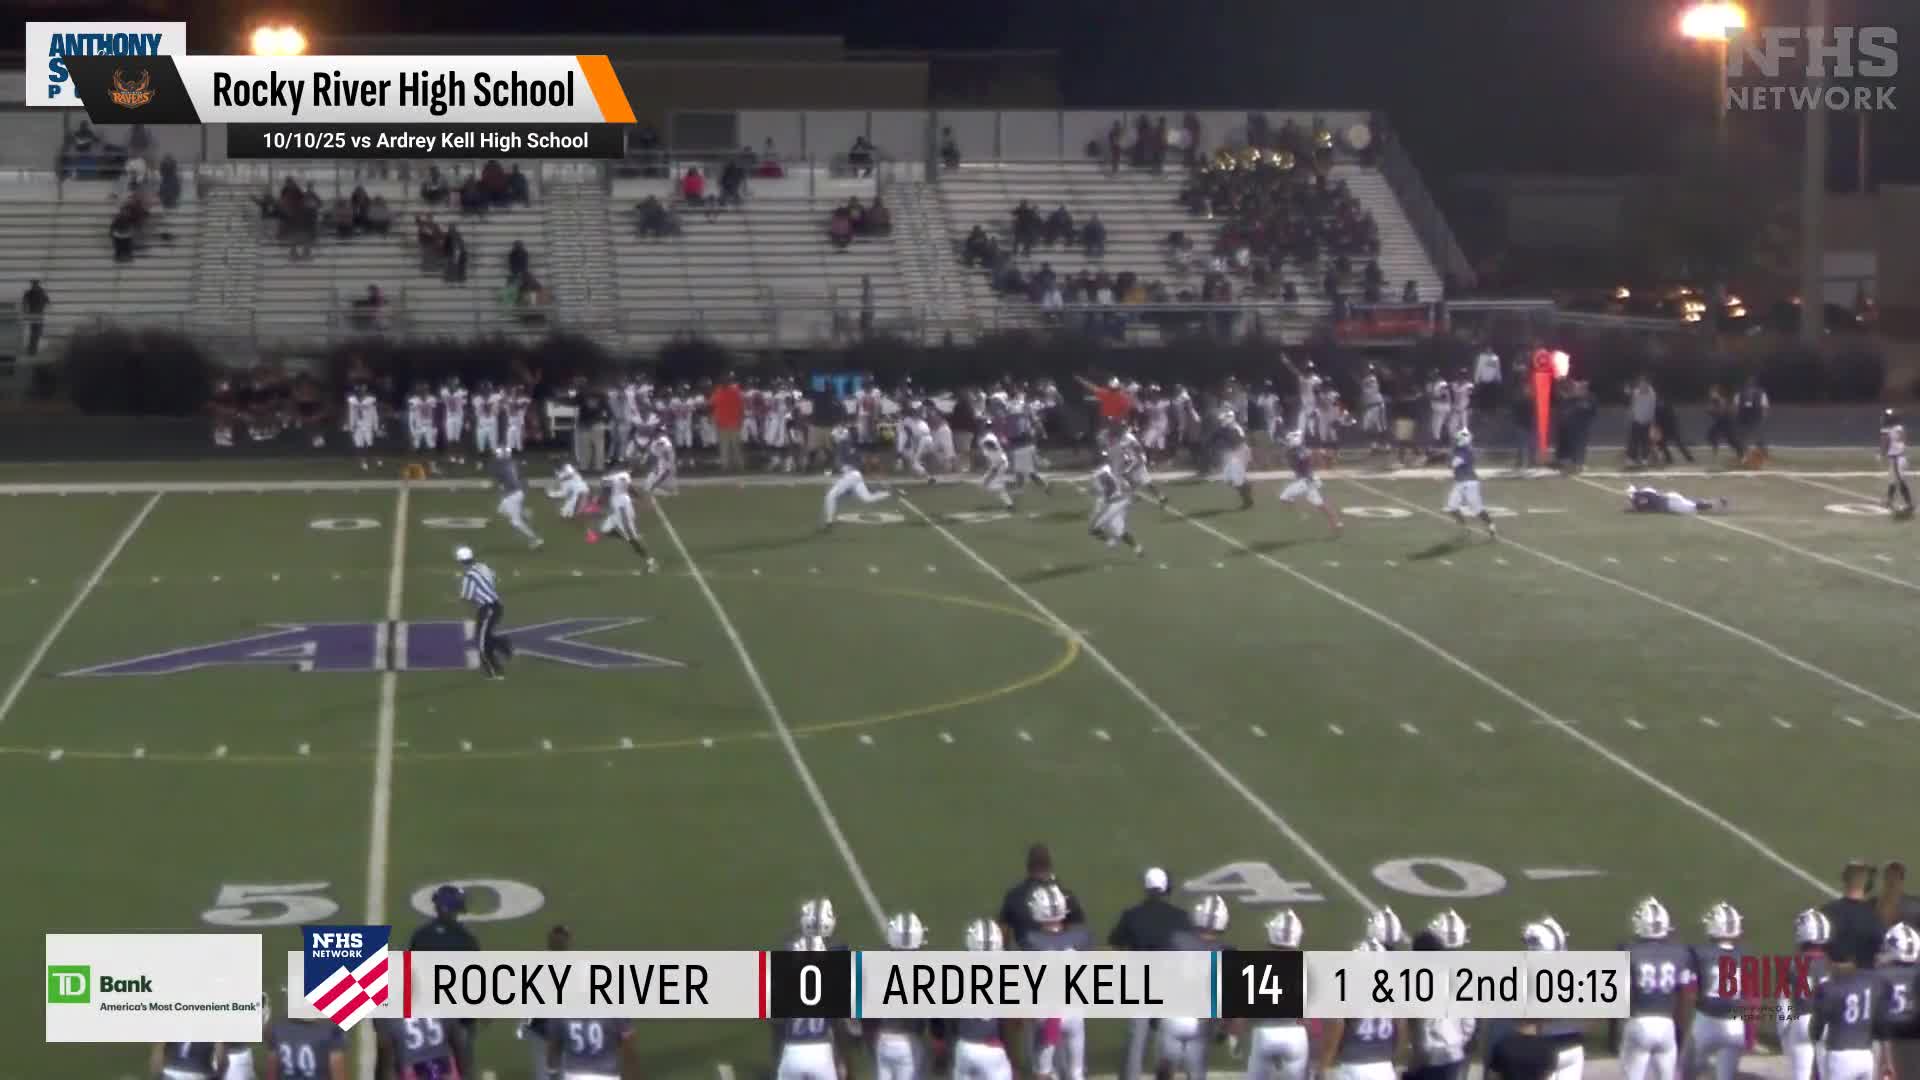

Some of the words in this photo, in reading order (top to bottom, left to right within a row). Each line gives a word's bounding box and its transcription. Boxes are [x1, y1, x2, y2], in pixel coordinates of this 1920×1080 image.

[1639, 961, 1676, 994] 88
[1844, 987, 1872, 1024] 81
[568, 1022, 604, 1053] 59
